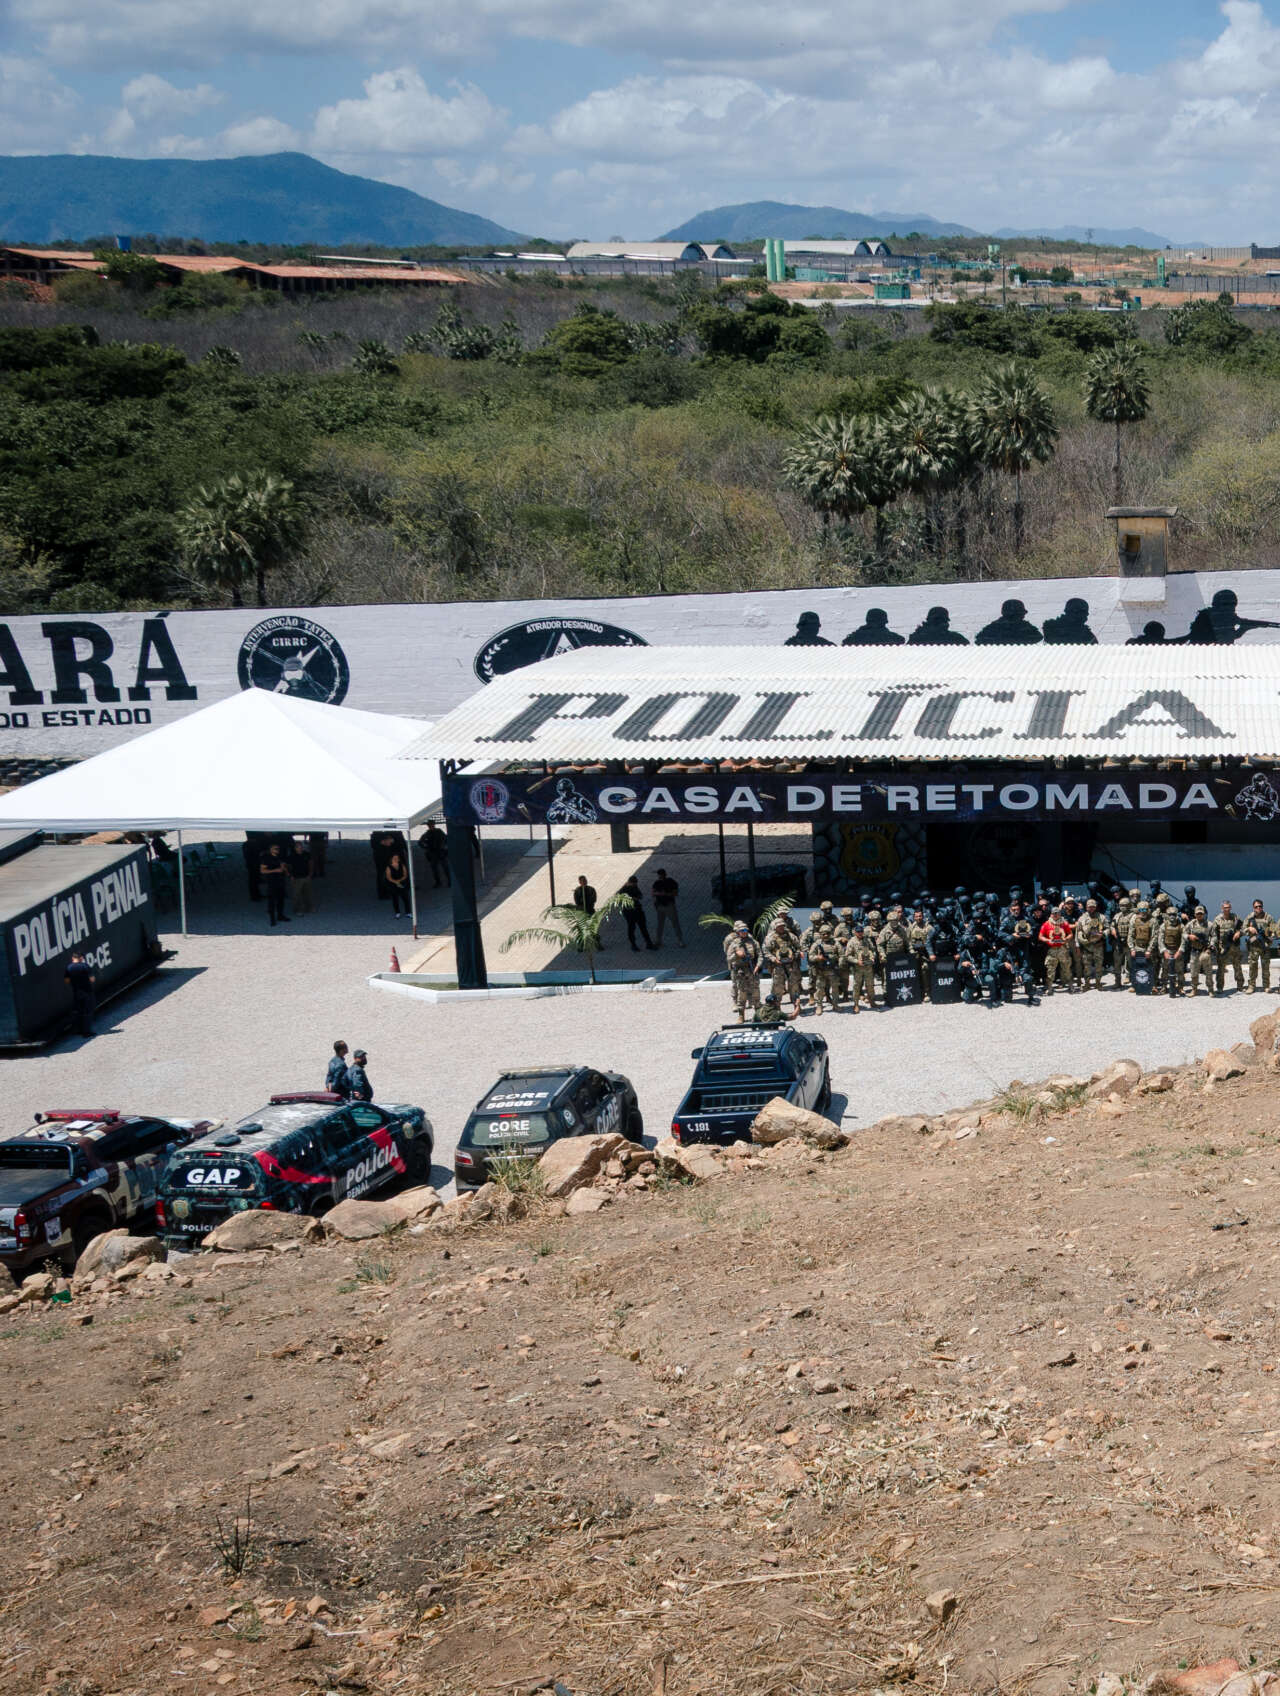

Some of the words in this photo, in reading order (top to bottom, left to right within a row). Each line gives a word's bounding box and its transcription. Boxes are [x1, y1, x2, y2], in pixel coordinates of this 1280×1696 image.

[243, 616, 299, 651] INTERVENÇÃO
[304, 621, 335, 646] TÁTICA
[526, 620, 561, 634] ATIRADOR
[562, 620, 604, 633] DESIGNADO
[272, 637, 308, 647] CIRRC
[42, 708, 152, 728] ESTADO
[473, 683, 1237, 743] POLÍCIA
[598, 786, 763, 813] CASA
[787, 785, 863, 811] DE
[887, 783, 1218, 811] RETOMADA
[14, 896, 90, 977] POLÍCIA
[91, 860, 148, 930] PENAL
[890, 969, 916, 980] BOPE
[491, 1091, 549, 1101] CORE
[489, 1120, 530, 1133] CORE
[346, 1141, 399, 1189] POLÍCIA
[186, 1168, 241, 1184] GAP
